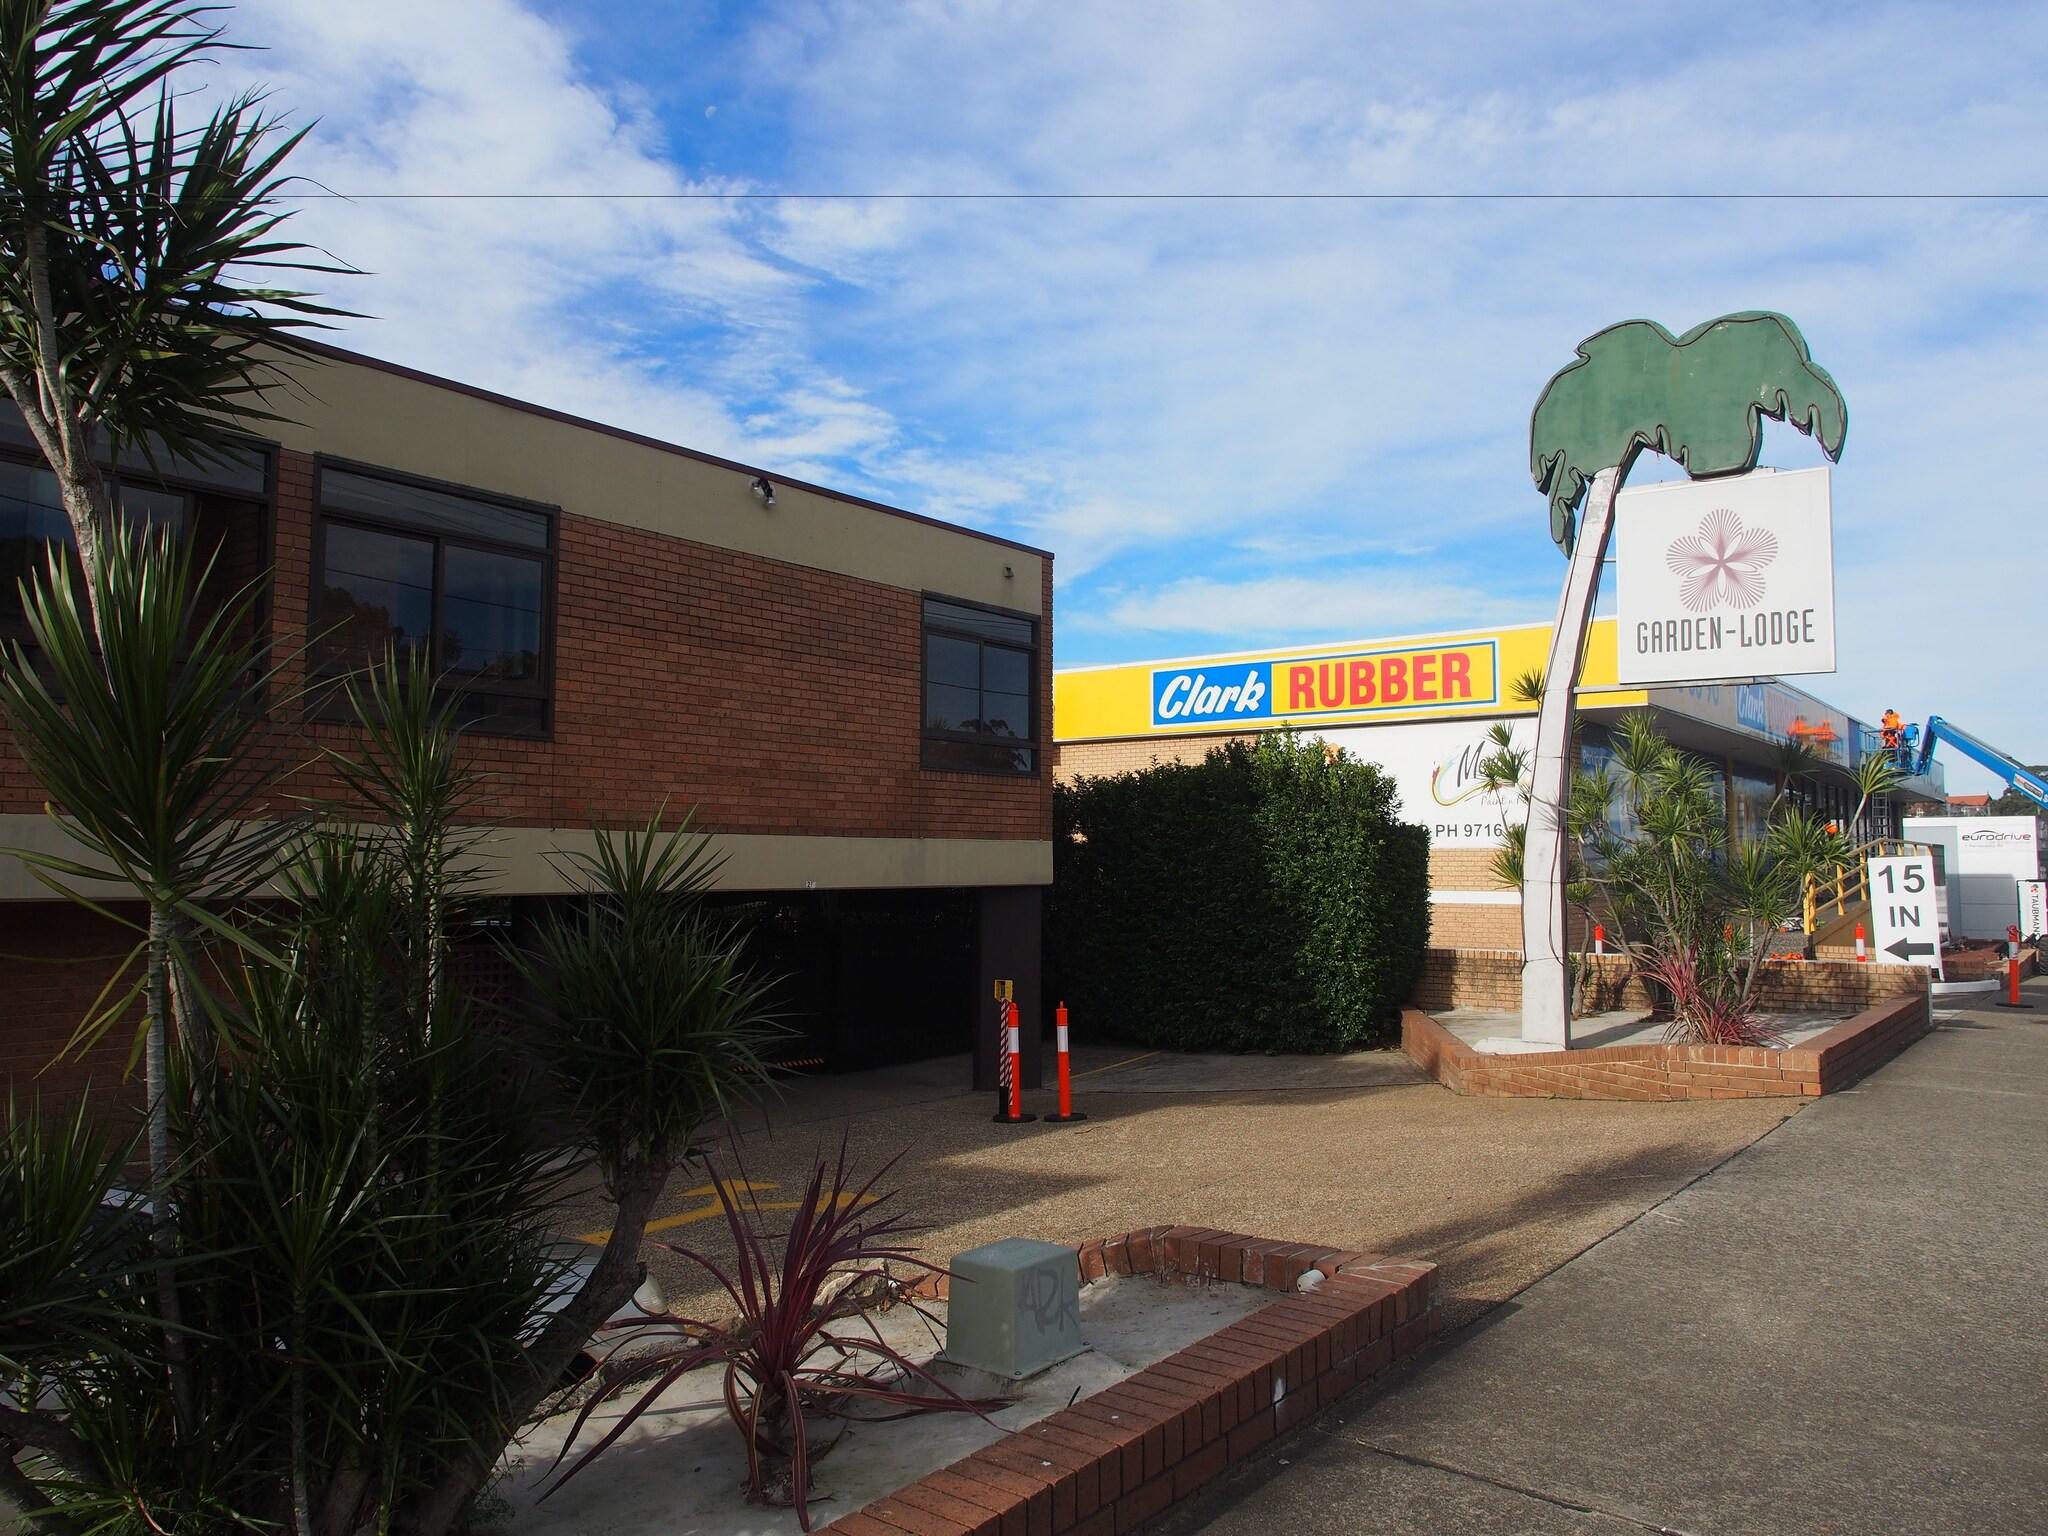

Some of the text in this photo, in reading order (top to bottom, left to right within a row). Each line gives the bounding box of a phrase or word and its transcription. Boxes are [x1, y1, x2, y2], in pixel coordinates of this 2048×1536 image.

[1636, 608, 1816, 655] GARDEN-LODGE
[1157, 652, 1472, 719] Clark RUBBER
[1435, 824, 1458, 837] PH
[1463, 824, 1503, 837] 9716
[1961, 831, 2032, 842] eurodrive
[1878, 864, 1926, 895] 15
[1889, 905, 1921, 927] IN
